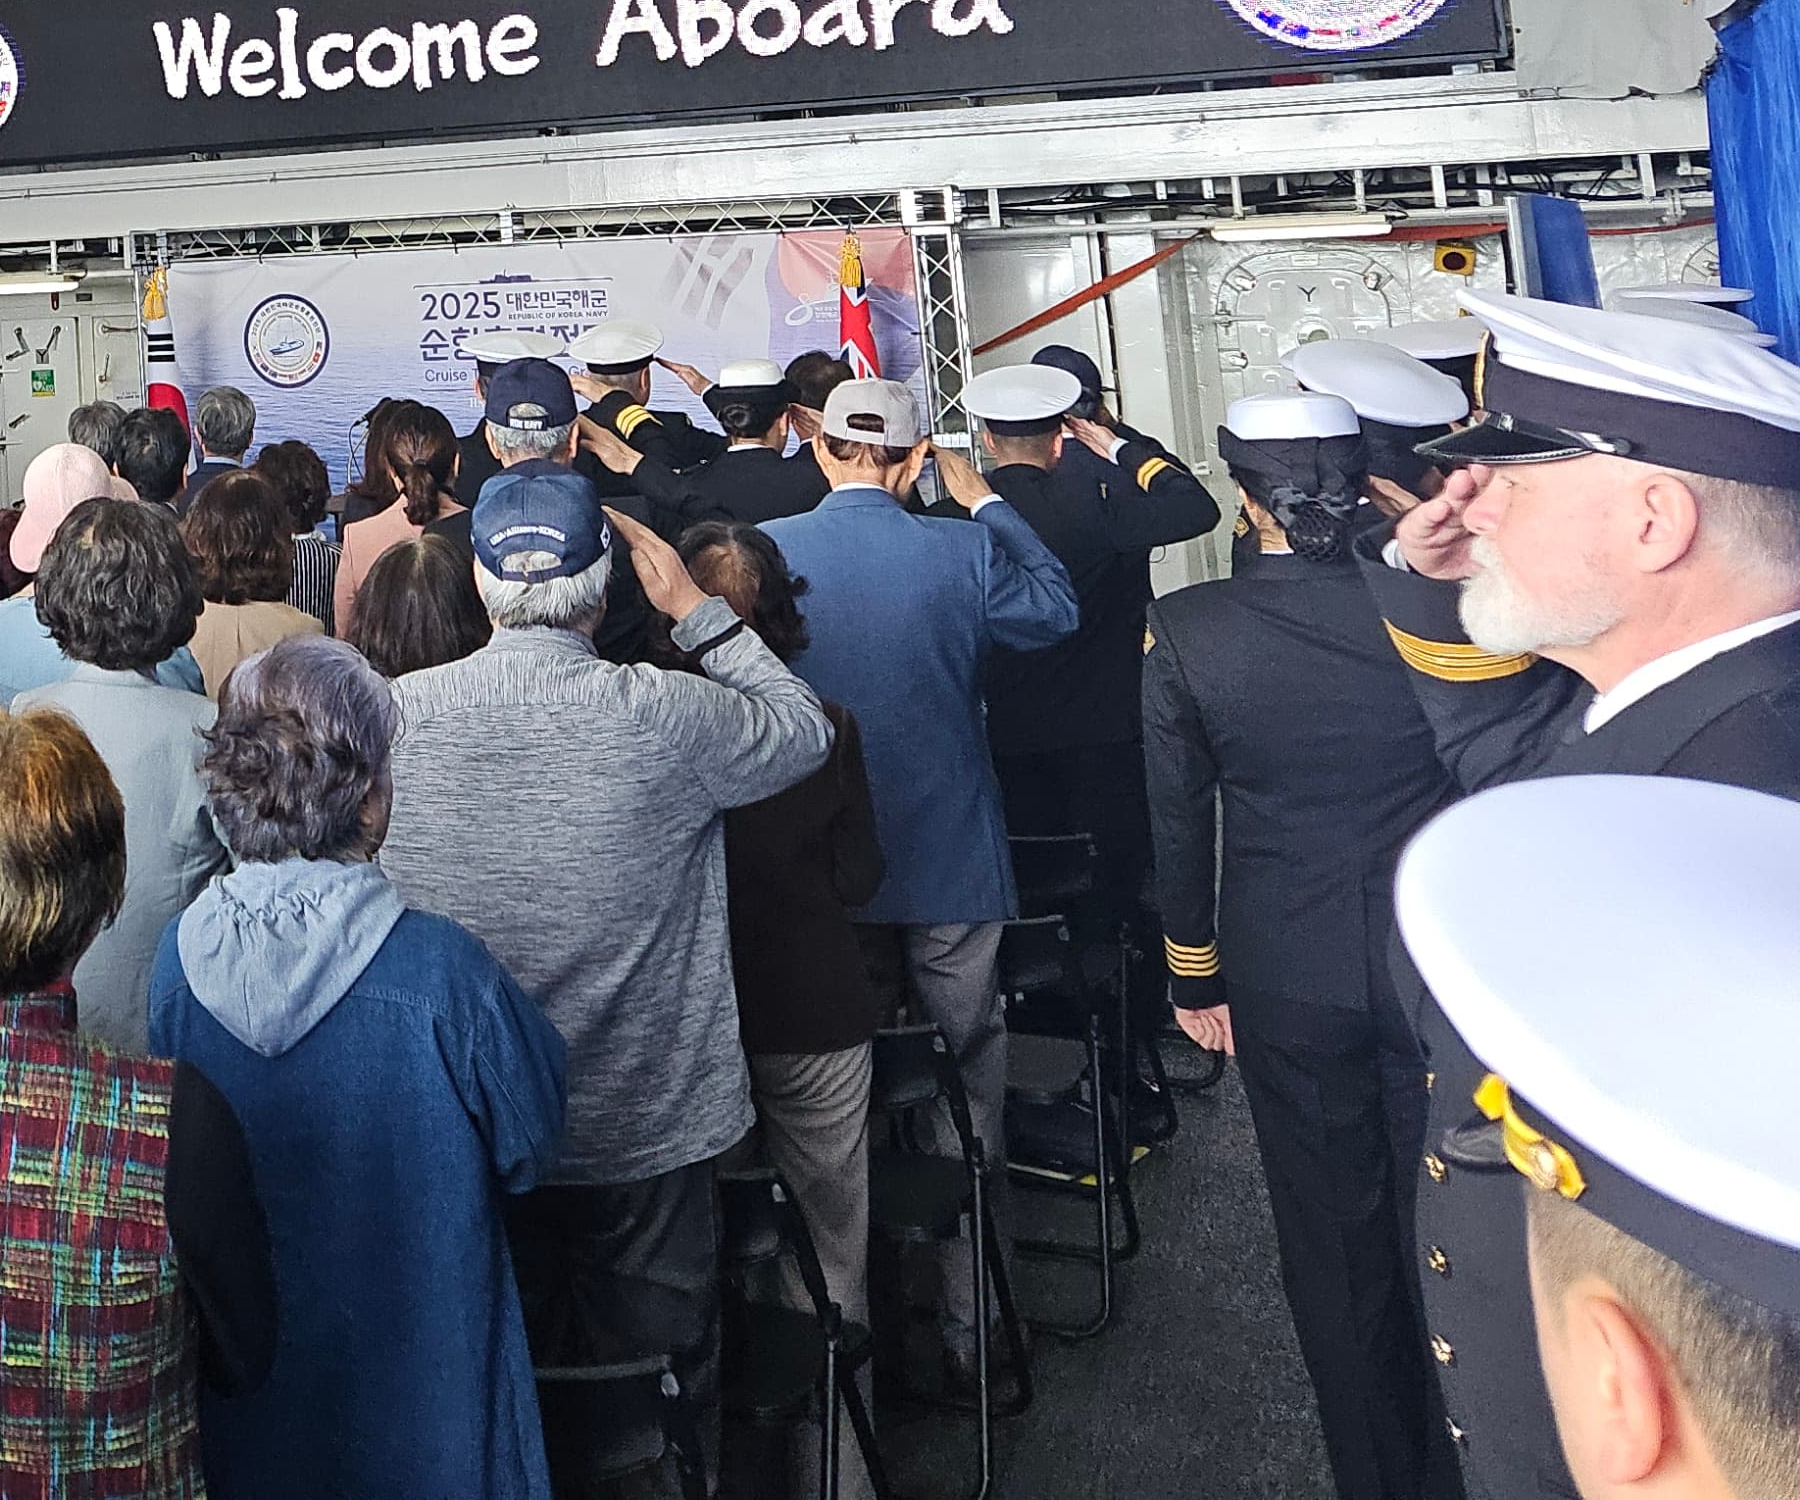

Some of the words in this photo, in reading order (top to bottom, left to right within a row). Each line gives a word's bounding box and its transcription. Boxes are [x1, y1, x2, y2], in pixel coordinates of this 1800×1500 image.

[151, 6, 542, 101] Welcome
[421, 291, 501, 321] 2025
[506, 290, 607, 311] 대한민국해군
[558, 311, 583, 319] KOREA
[586, 310, 608, 318] NAVY
[425, 368, 467, 382] Cruise
